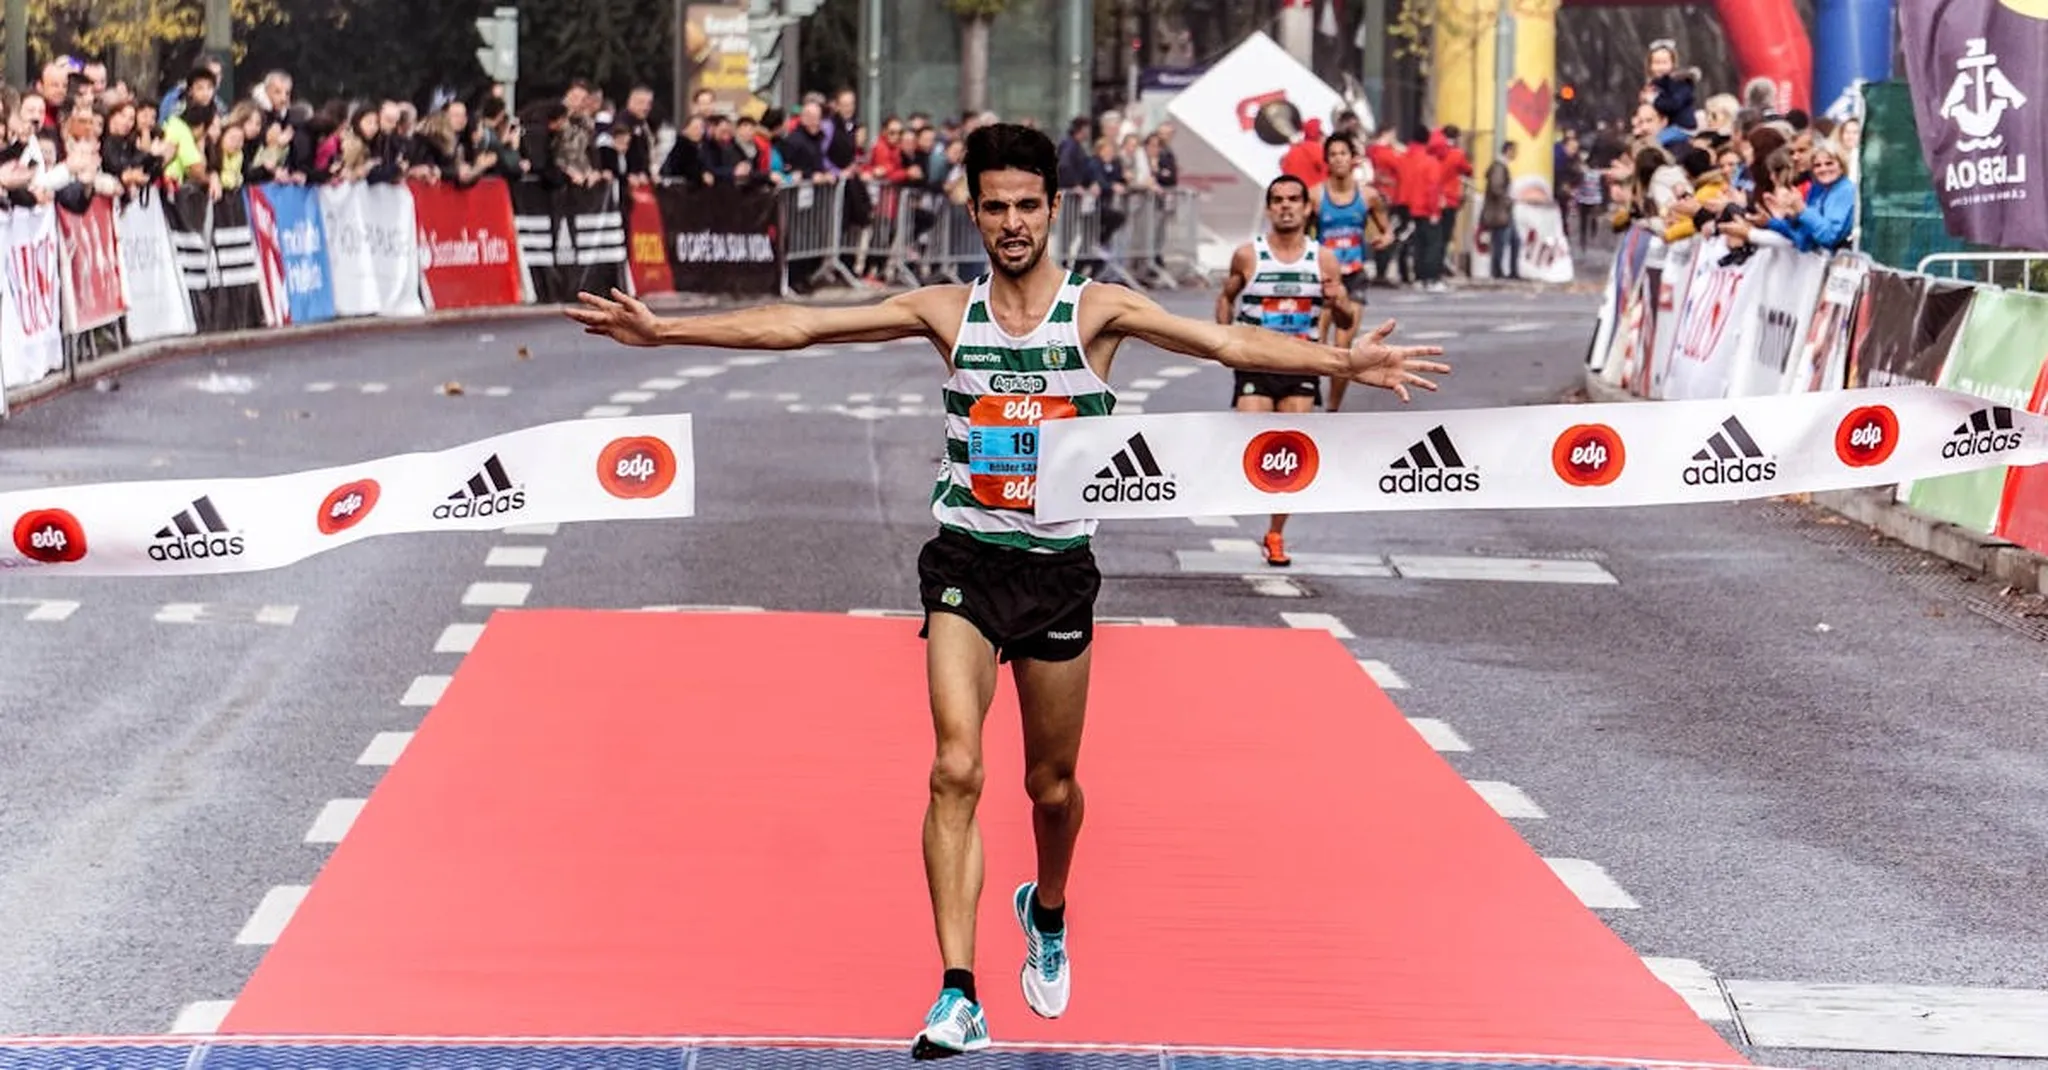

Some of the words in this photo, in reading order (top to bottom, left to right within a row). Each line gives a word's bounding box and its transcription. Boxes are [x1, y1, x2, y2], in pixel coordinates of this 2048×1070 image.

[1003, 396, 1043, 425] edp
[1010, 432, 1035, 455] 19
[1082, 478, 1176, 502] adidas
[1260, 447, 1298, 475] edp
[1379, 468, 1480, 493] adidas
[1570, 441, 1607, 468] edp
[1682, 458, 1777, 485] adidas
[1850, 422, 1882, 449] edp
[1941, 431, 2022, 459] adidas
[31, 525, 67, 550] edp
[148, 534, 244, 561] adidas
[330, 492, 362, 517] edp
[432, 490, 525, 520] adidas
[615, 454, 655, 481] edp
